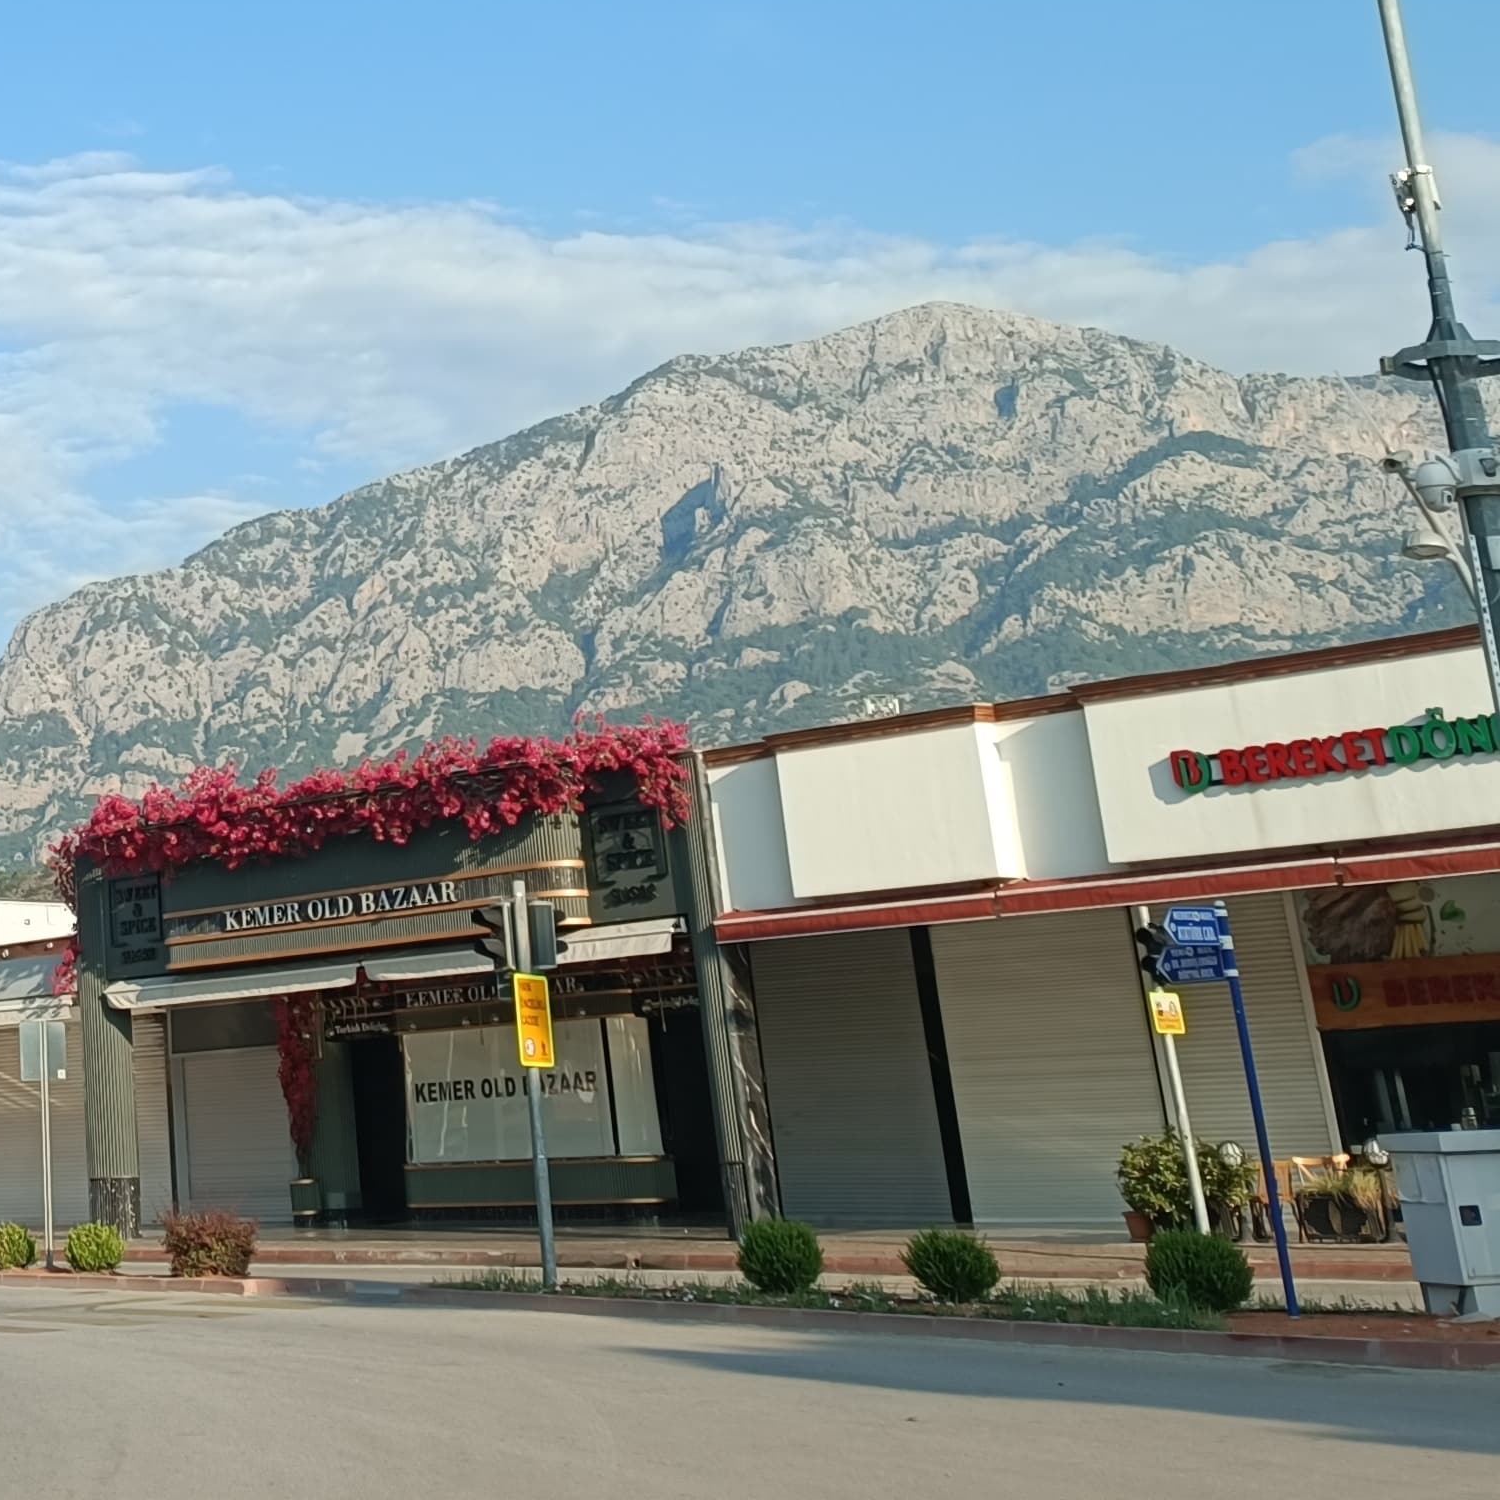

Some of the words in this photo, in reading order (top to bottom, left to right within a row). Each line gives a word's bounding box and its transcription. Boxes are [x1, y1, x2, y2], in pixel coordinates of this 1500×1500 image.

[1218, 727, 1388, 787] BEREKET
[1387, 707, 1500, 766] DÖN
[225, 902, 301, 931] KEMER
[307, 895, 354, 921] OLD
[359, 881, 458, 914] BAZAAR
[406, 986, 465, 1008] KEMER
[415, 1080, 476, 1103] KEMER
[481, 1077, 516, 1099] OLD
